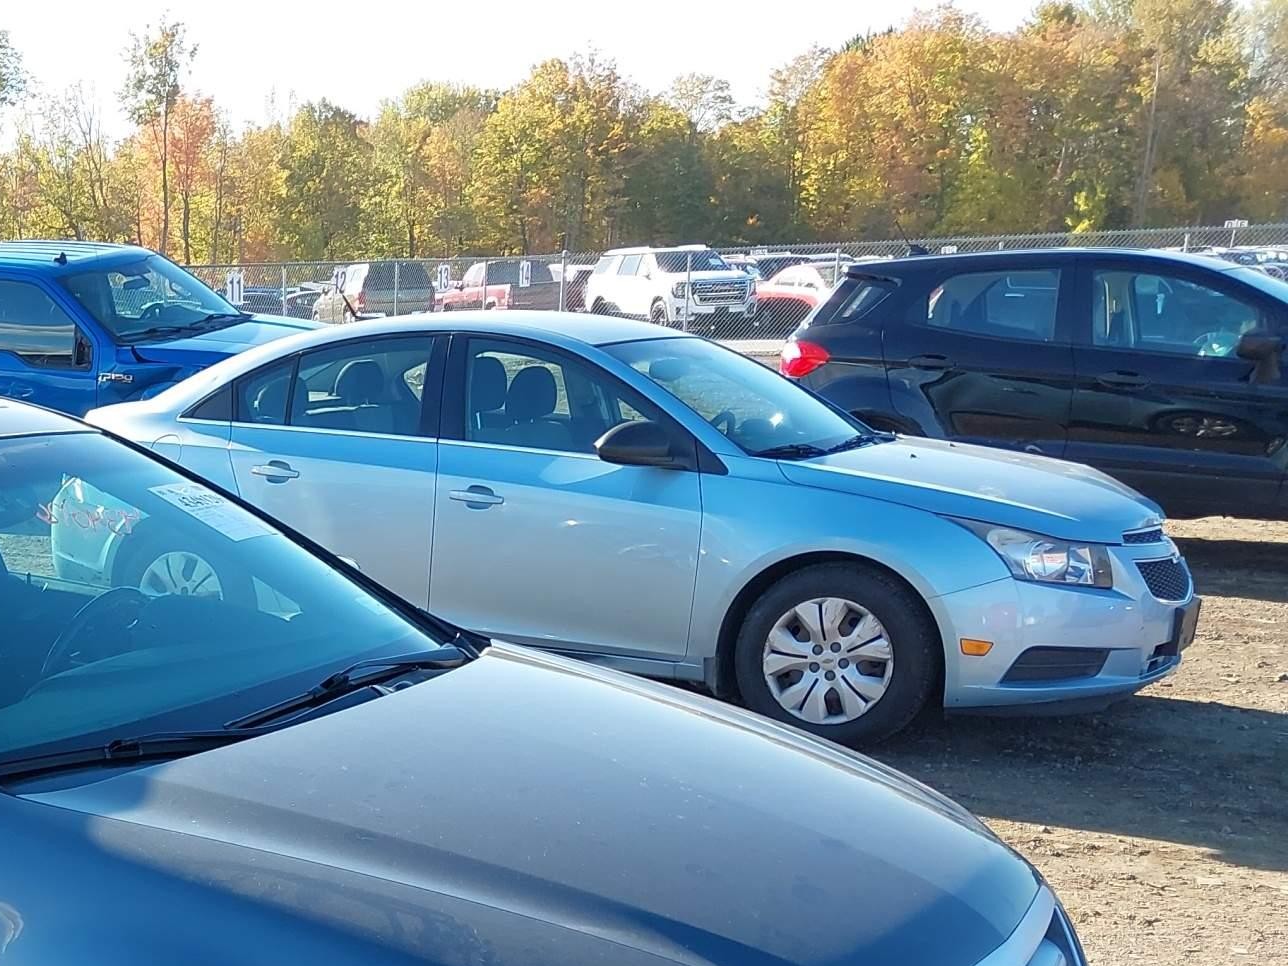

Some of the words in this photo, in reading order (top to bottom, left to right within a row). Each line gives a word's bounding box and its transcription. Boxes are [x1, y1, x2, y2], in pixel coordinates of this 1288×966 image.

[228, 277, 243, 302] 11
[334, 271, 347, 294] 12
[439, 267, 450, 289] 13
